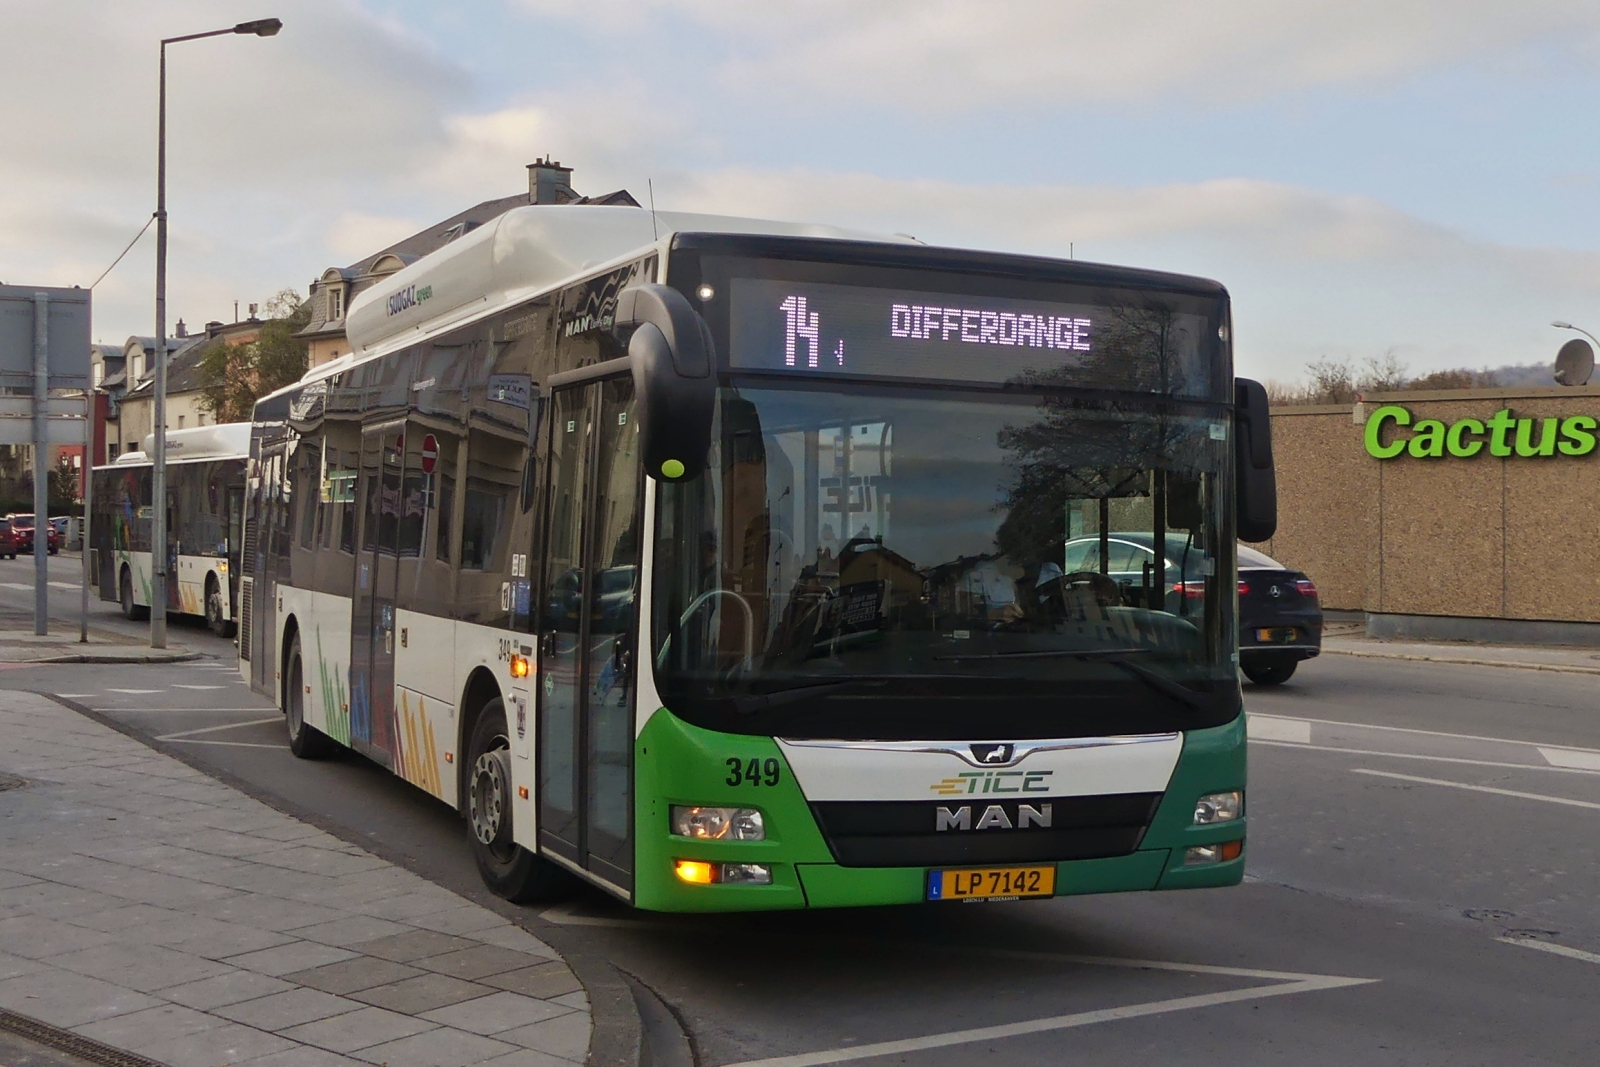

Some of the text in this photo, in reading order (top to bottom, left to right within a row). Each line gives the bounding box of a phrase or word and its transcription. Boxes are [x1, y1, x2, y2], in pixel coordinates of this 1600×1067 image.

[565, 315, 590, 338] MAN
[779, 295, 1091, 368] 14 DIFFERDANGE
[1364, 405, 1597, 459] Cactus
[498, 638, 511, 662] 349
[724, 757, 781, 787] 349
[935, 803, 1053, 832] MAN
[932, 870, 1041, 895] L LP 7142
